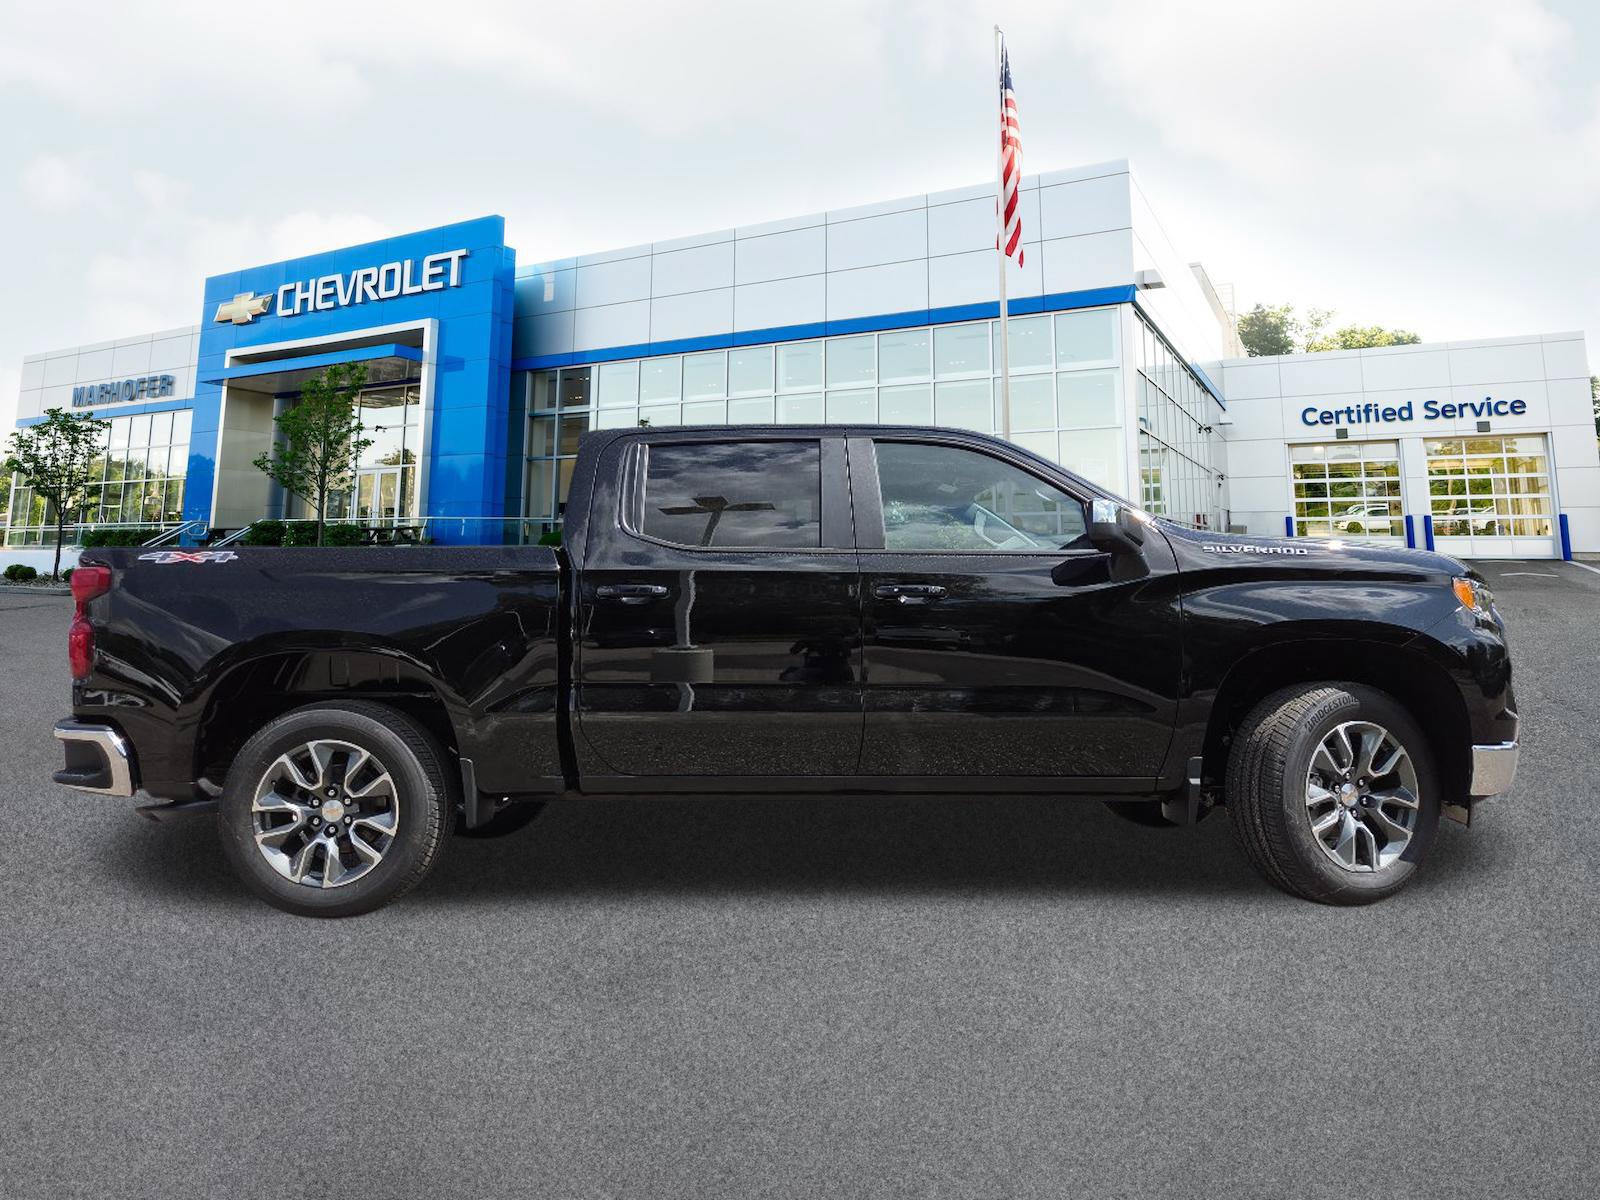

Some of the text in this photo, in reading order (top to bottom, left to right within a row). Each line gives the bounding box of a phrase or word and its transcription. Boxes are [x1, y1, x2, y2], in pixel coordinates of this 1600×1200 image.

[277, 248, 469, 317] CHEVROLET
[72, 374, 176, 408] MARHOFER
[1301, 396, 1527, 426] Certified Service
[1202, 545, 1308, 555] SILVERADO
